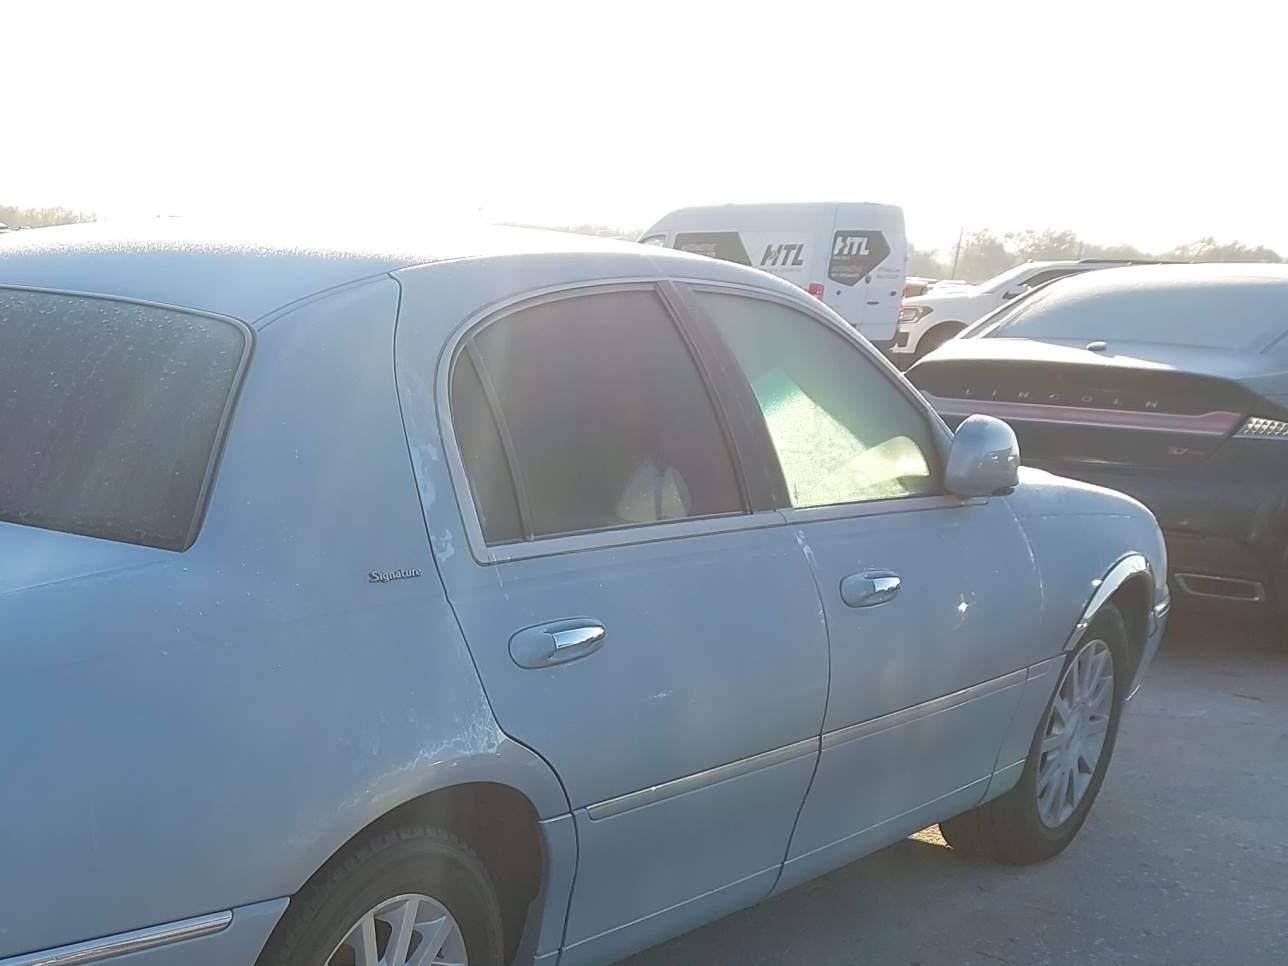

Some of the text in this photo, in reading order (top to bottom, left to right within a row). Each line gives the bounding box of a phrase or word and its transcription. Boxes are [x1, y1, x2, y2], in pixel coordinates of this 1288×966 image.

[760, 243, 805, 266] HTL
[833, 236, 870, 255] HTL
[368, 567, 423, 583] Signature
